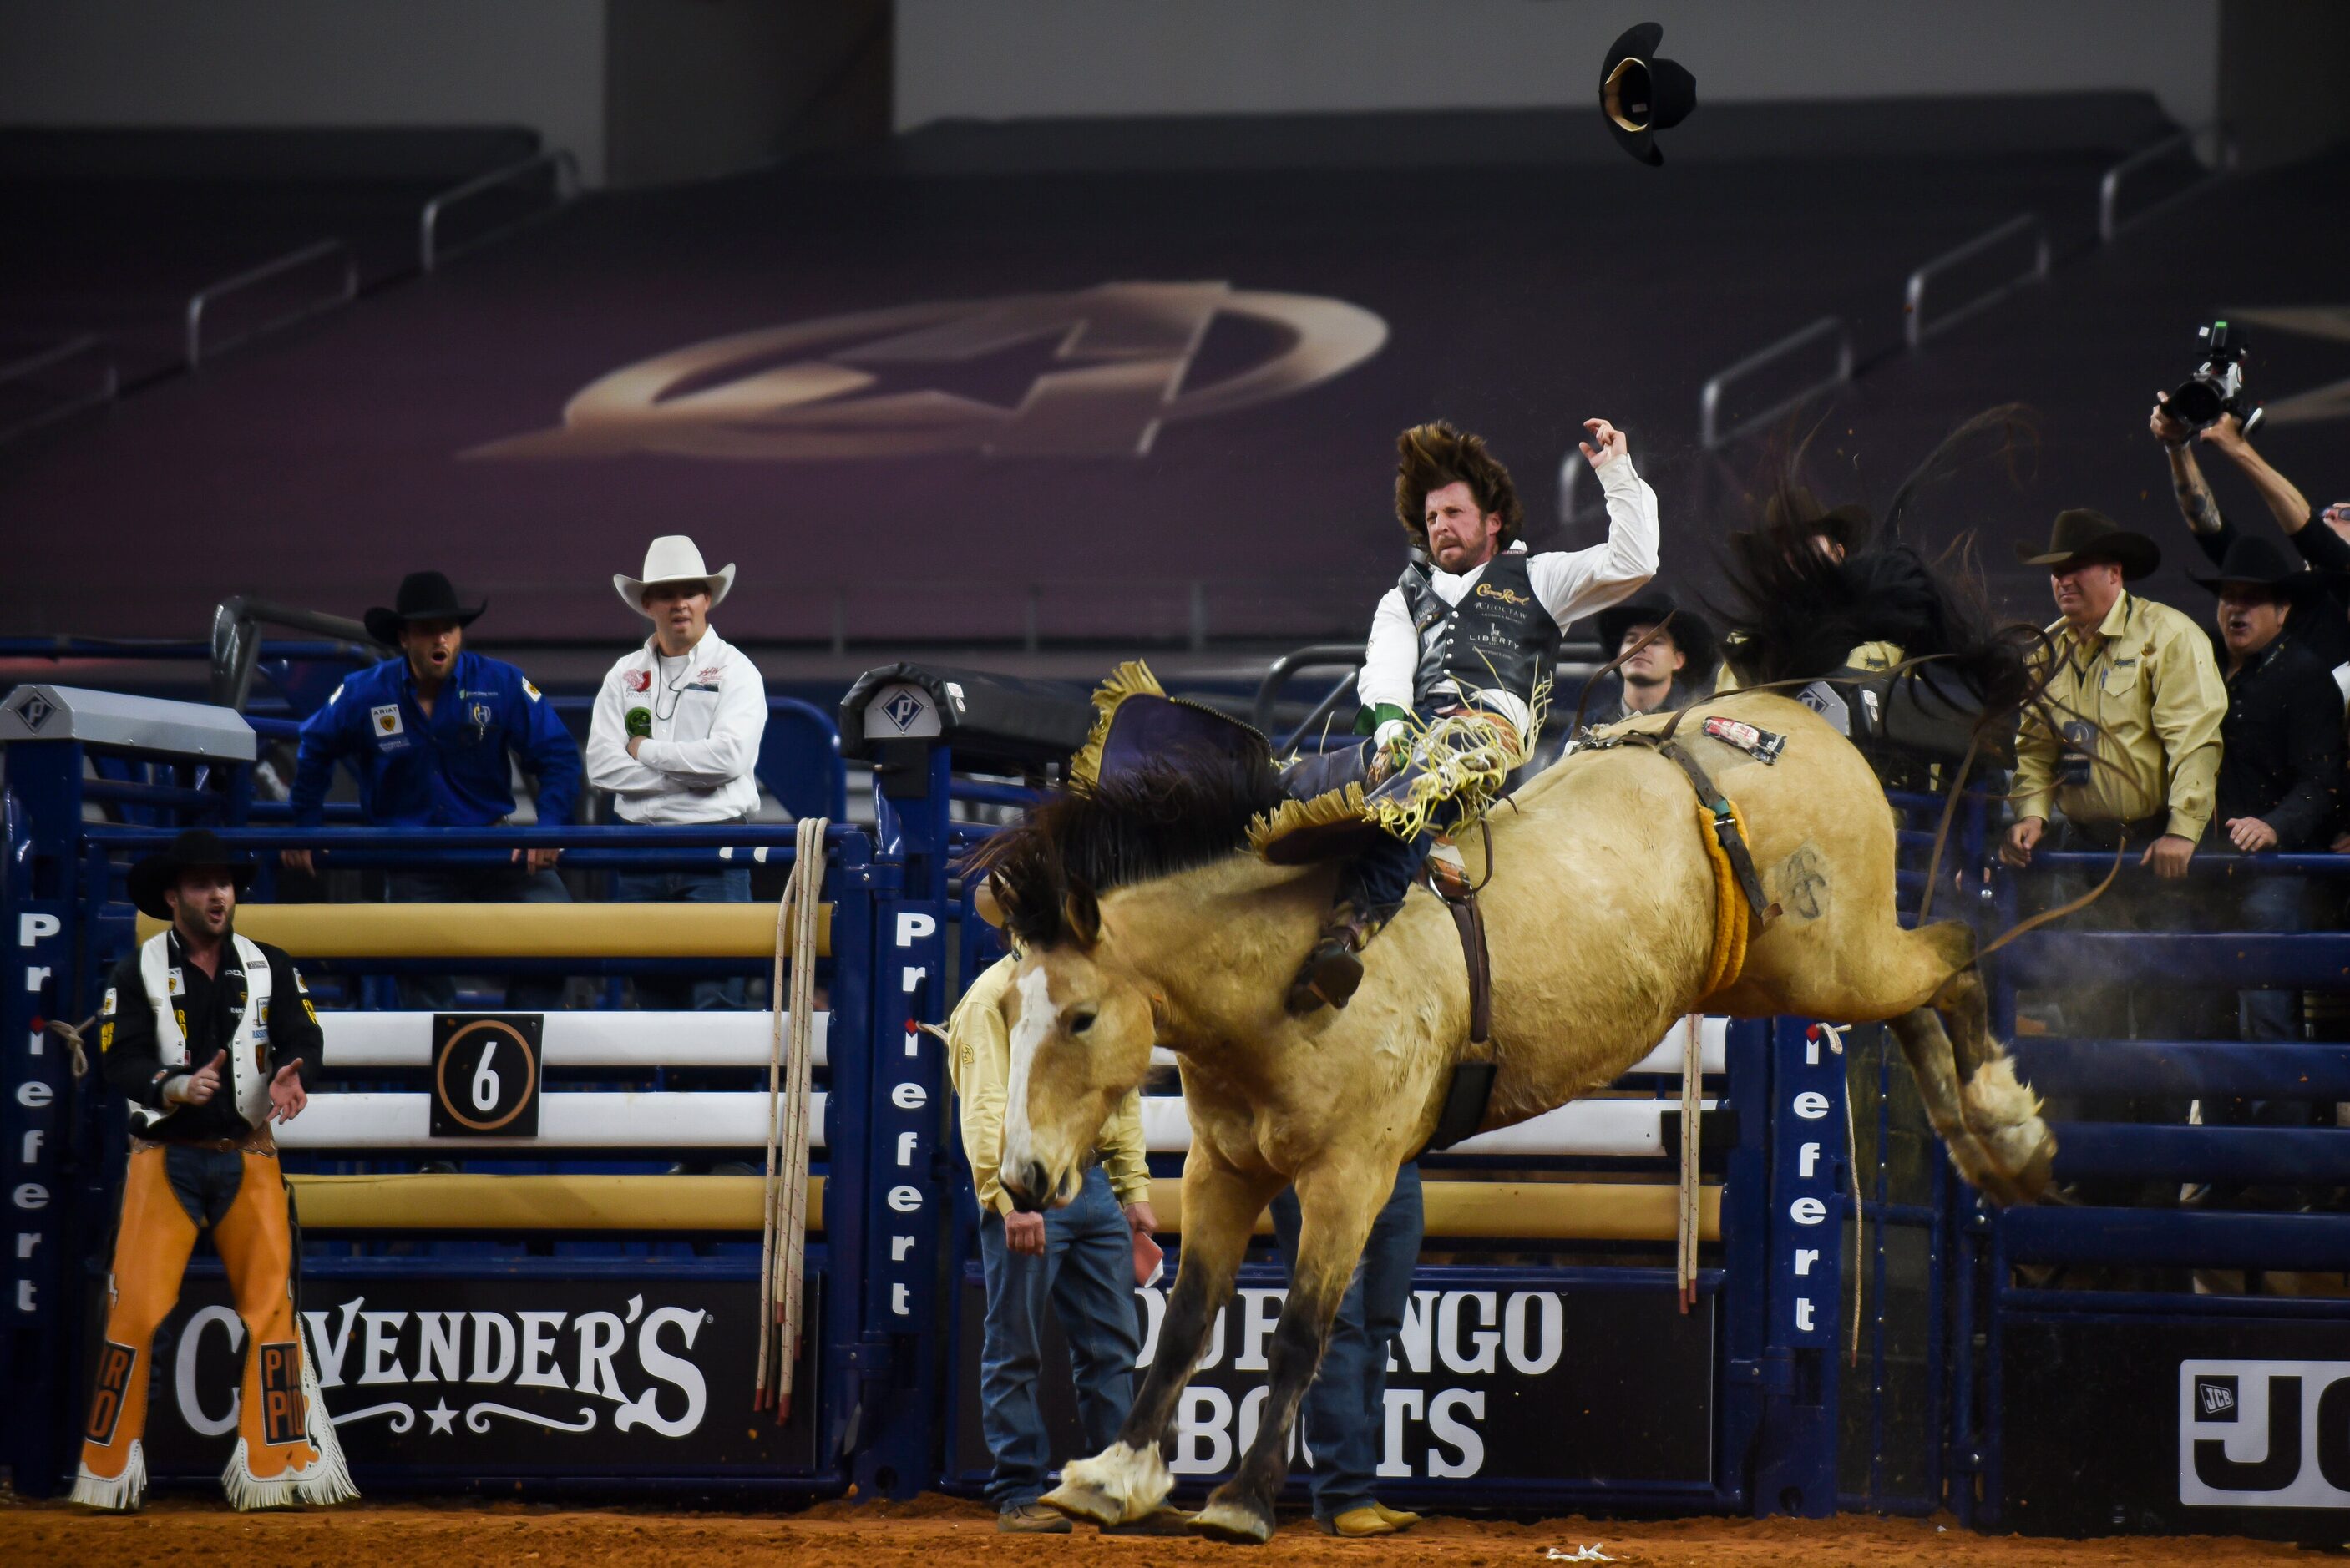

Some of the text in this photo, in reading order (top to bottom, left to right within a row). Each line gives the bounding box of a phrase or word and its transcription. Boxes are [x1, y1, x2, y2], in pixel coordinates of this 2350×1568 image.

[1469, 635, 1520, 650] LIBERTY
[373, 706, 398, 716] ARIAT
[12, 913, 61, 1313] Priefert
[471, 1041, 499, 1113] 6
[887, 913, 936, 1317] Priefert
[1790, 1024, 1830, 1333] iefert
[175, 1293, 707, 1438] CVENDER'S
[1134, 1288, 1563, 1375] DRNGO
[1169, 1386, 1485, 1478] BOTS
[2205, 1387, 2231, 1411] JCB
